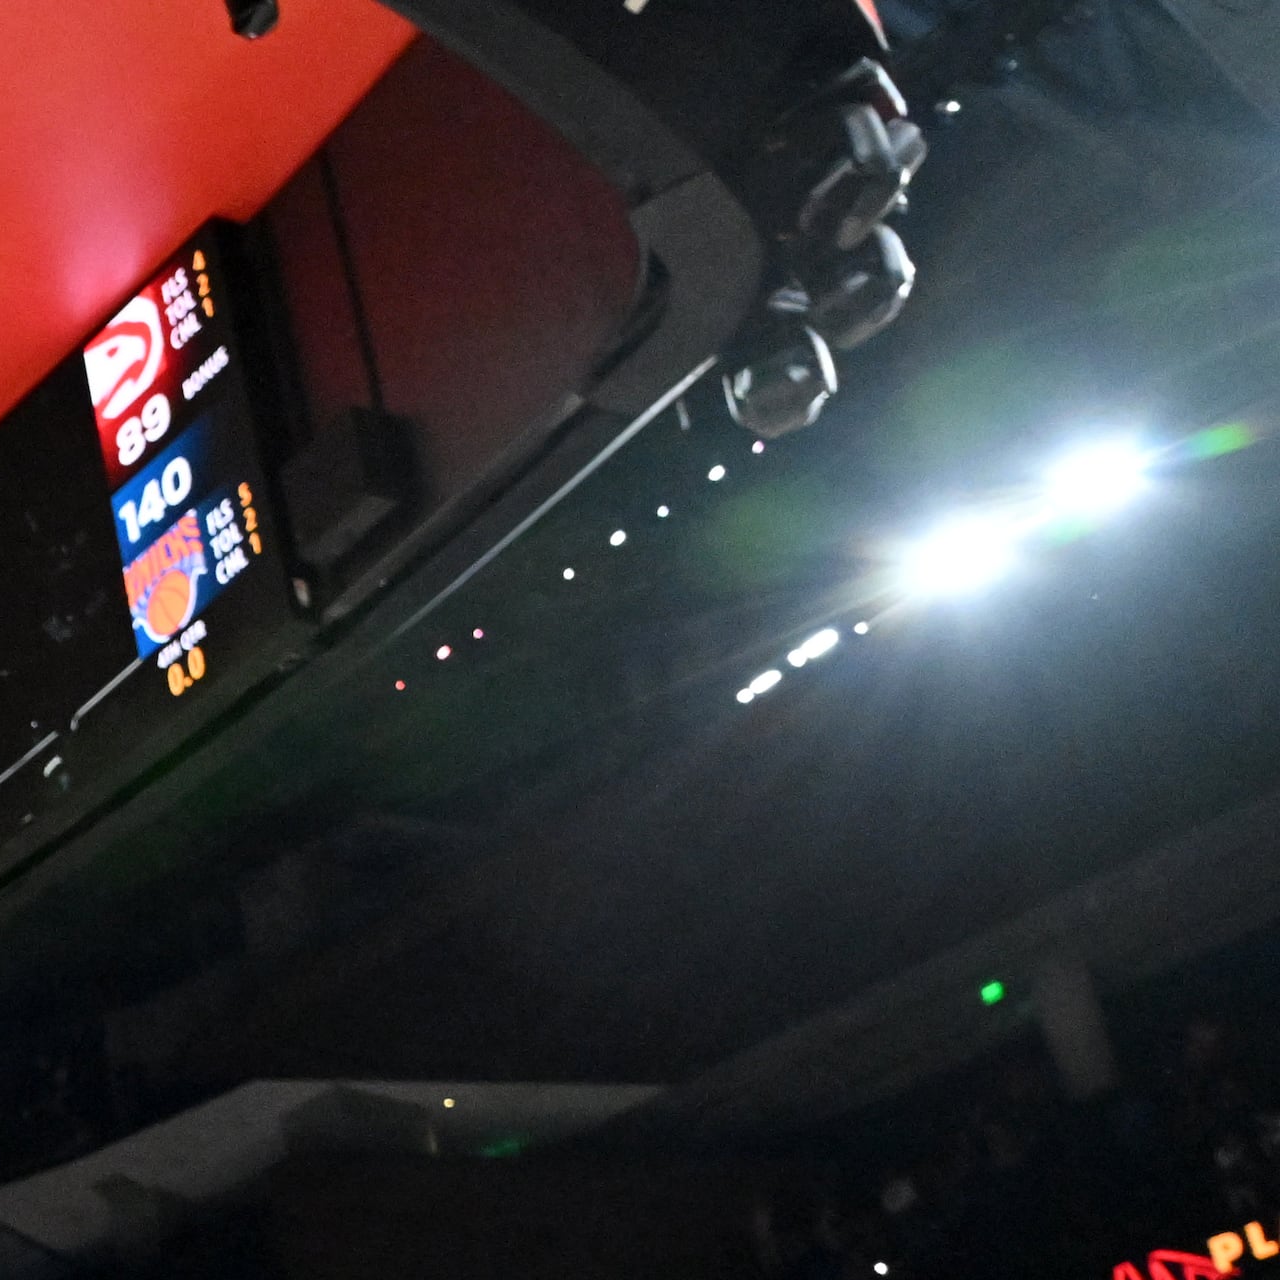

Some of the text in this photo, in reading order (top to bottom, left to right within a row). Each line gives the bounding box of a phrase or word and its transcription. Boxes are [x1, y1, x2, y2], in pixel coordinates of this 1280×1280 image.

[115, 393, 172, 466] 89
[117, 455, 193, 543] 140
[1206, 1219, 1275, 1274] PL
